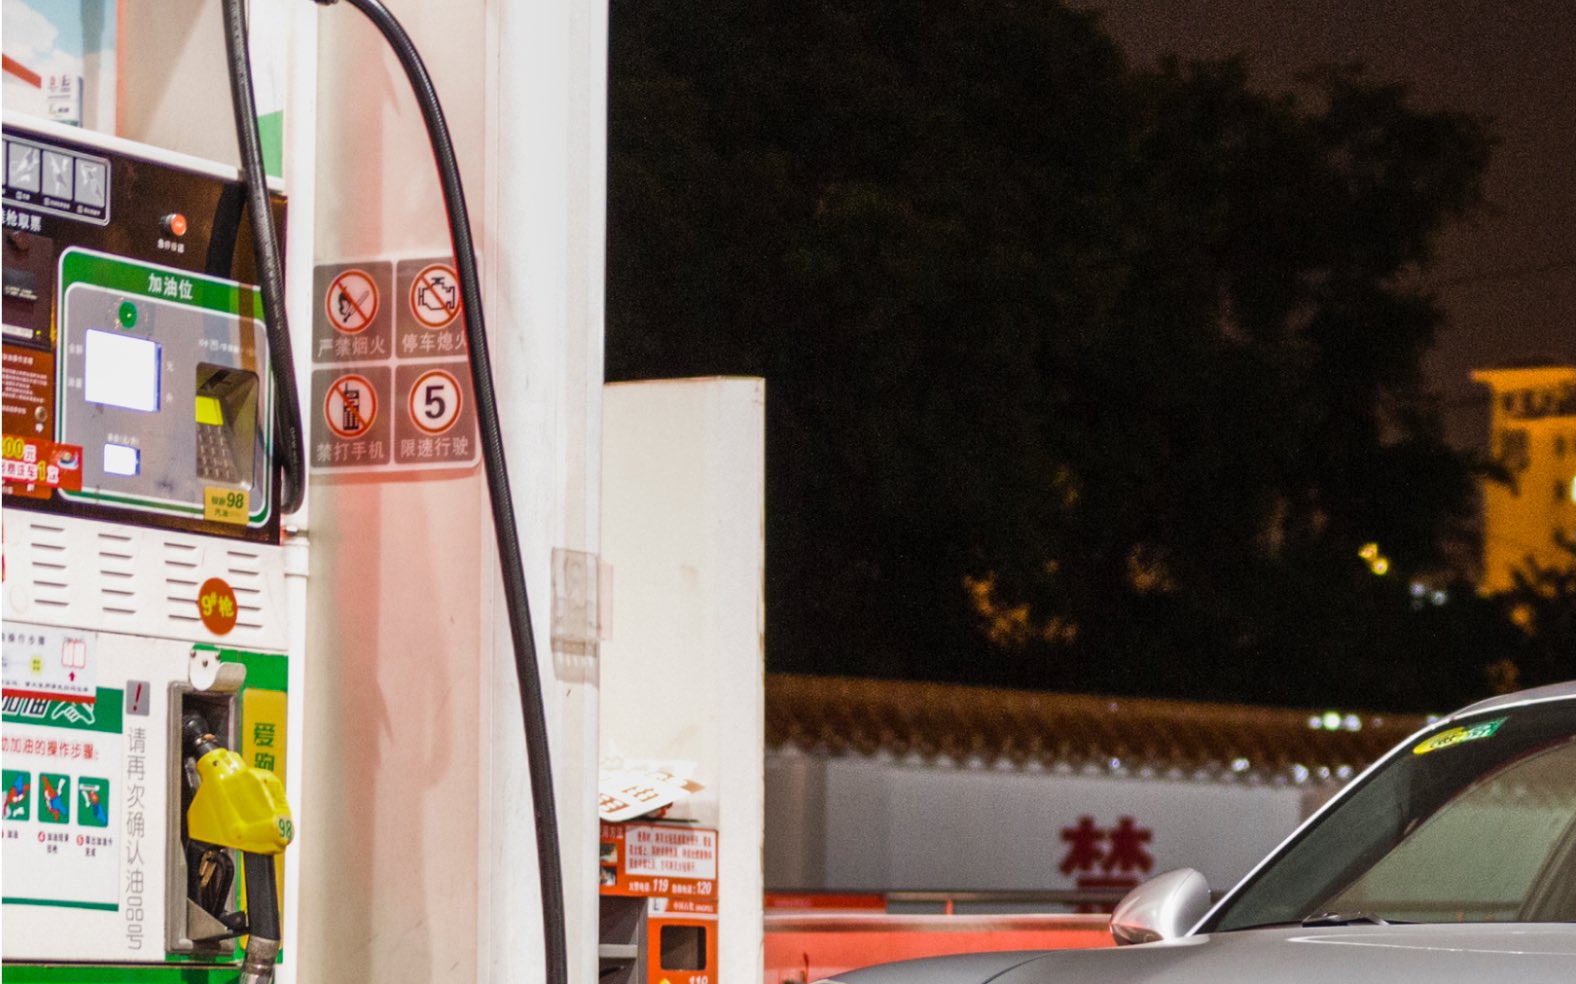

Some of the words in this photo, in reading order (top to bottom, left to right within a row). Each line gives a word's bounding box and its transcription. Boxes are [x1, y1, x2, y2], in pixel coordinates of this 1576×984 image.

[148, 273, 194, 299] 加油位
[317, 334, 386, 358] 严禁烟火
[424, 384, 446, 419] 5
[316, 440, 385, 462] 禁打手机
[400, 436, 469, 458] 限速行驶
[126, 726, 147, 951] 请再次确认油品号
[278, 817, 292, 838] 98
